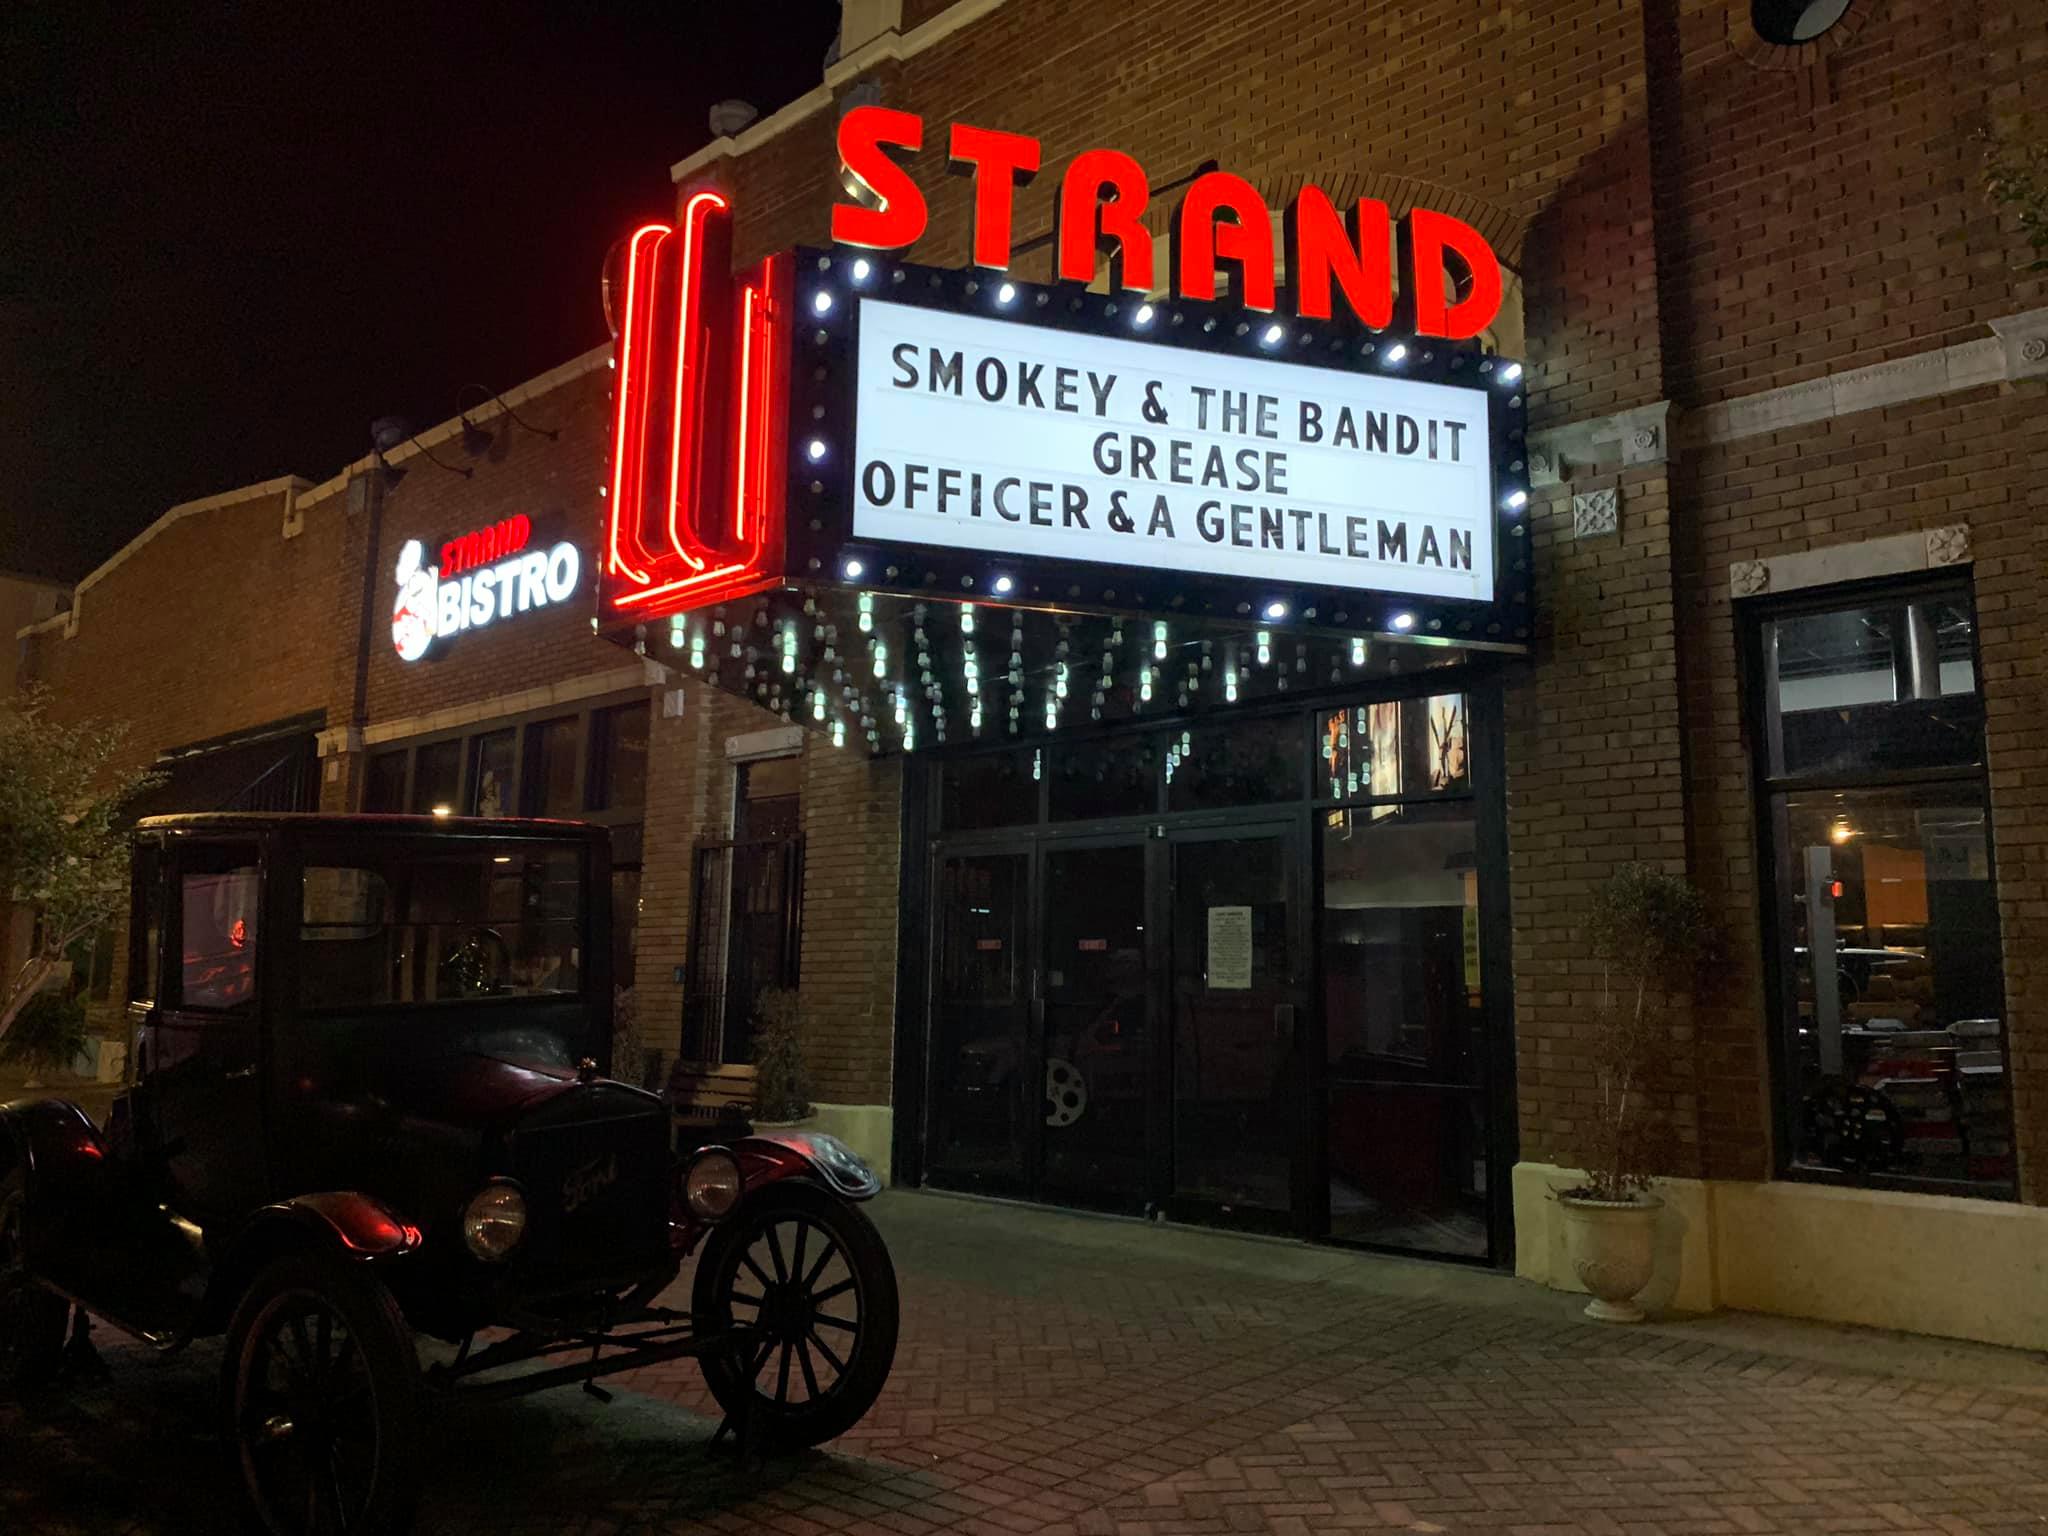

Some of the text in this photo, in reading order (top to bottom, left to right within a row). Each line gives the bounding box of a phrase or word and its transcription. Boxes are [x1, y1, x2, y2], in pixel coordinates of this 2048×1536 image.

[831, 105, 1502, 339] STRAND
[891, 344, 1467, 462] SMOKEY & THE BANDIT
[861, 460, 1474, 571] OFFICER & A GENTLEMAN
[1093, 432, 1289, 495] GREASE
[437, 541, 579, 638] BISTRO
[440, 514, 531, 578] STRAND
